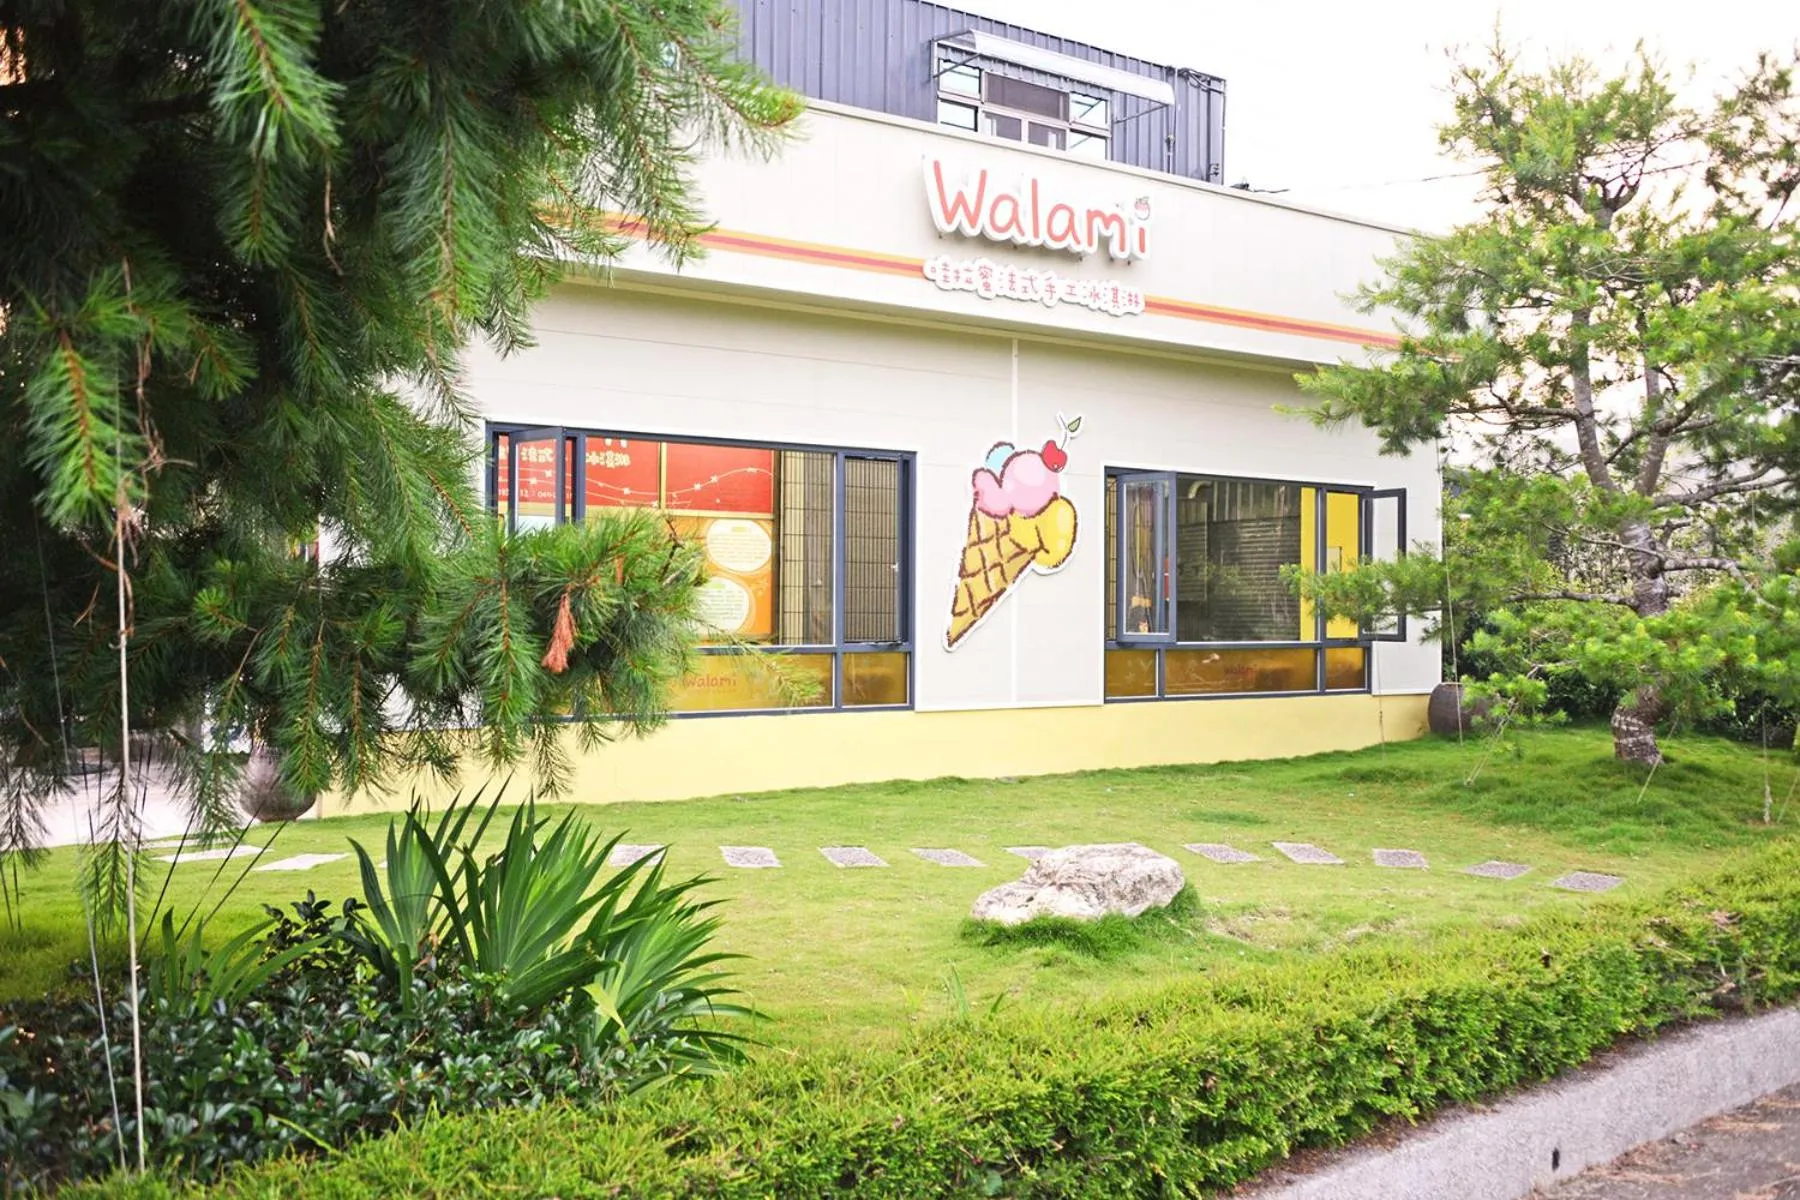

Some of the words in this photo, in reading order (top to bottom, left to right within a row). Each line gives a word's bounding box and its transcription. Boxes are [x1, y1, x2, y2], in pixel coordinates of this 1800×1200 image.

[933, 160, 1147, 254] Walami
[930, 262, 1141, 309] 哇拉蜜法式手工冰淇淋
